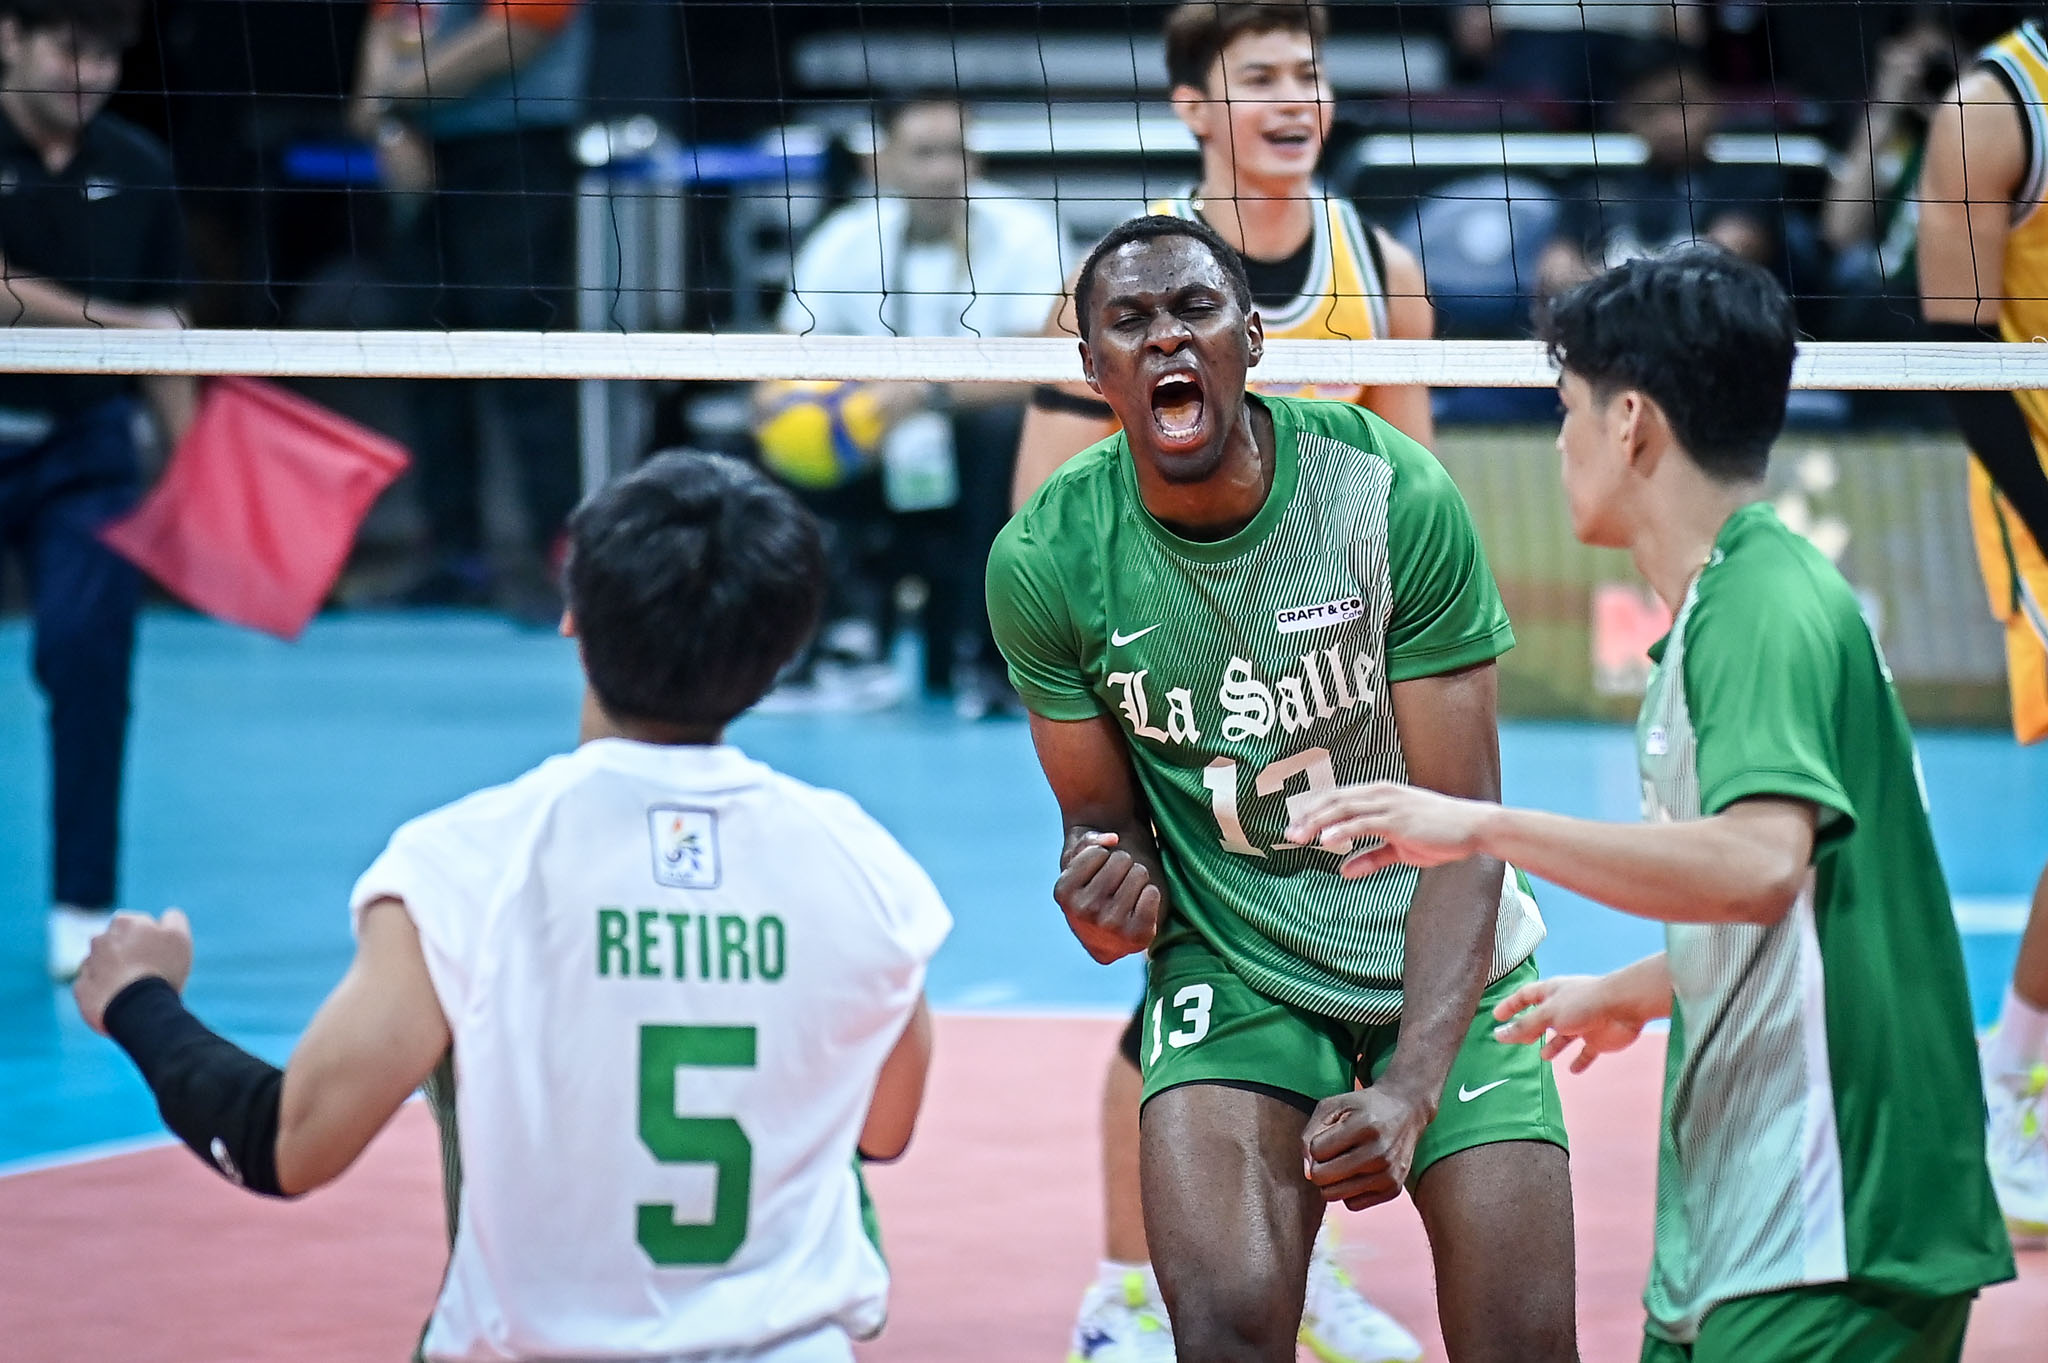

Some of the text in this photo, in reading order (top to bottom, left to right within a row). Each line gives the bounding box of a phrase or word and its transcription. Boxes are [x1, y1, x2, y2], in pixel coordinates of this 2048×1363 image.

[1278, 607, 1324, 623] CRAFT
[1327, 604, 1338, 615] &
[1342, 609, 1363, 620] Cafe
[1107, 643, 1376, 745] La Salle
[597, 908, 786, 981] RETIRO
[1149, 983, 1214, 1068] 13
[637, 1024, 757, 1266] 5
